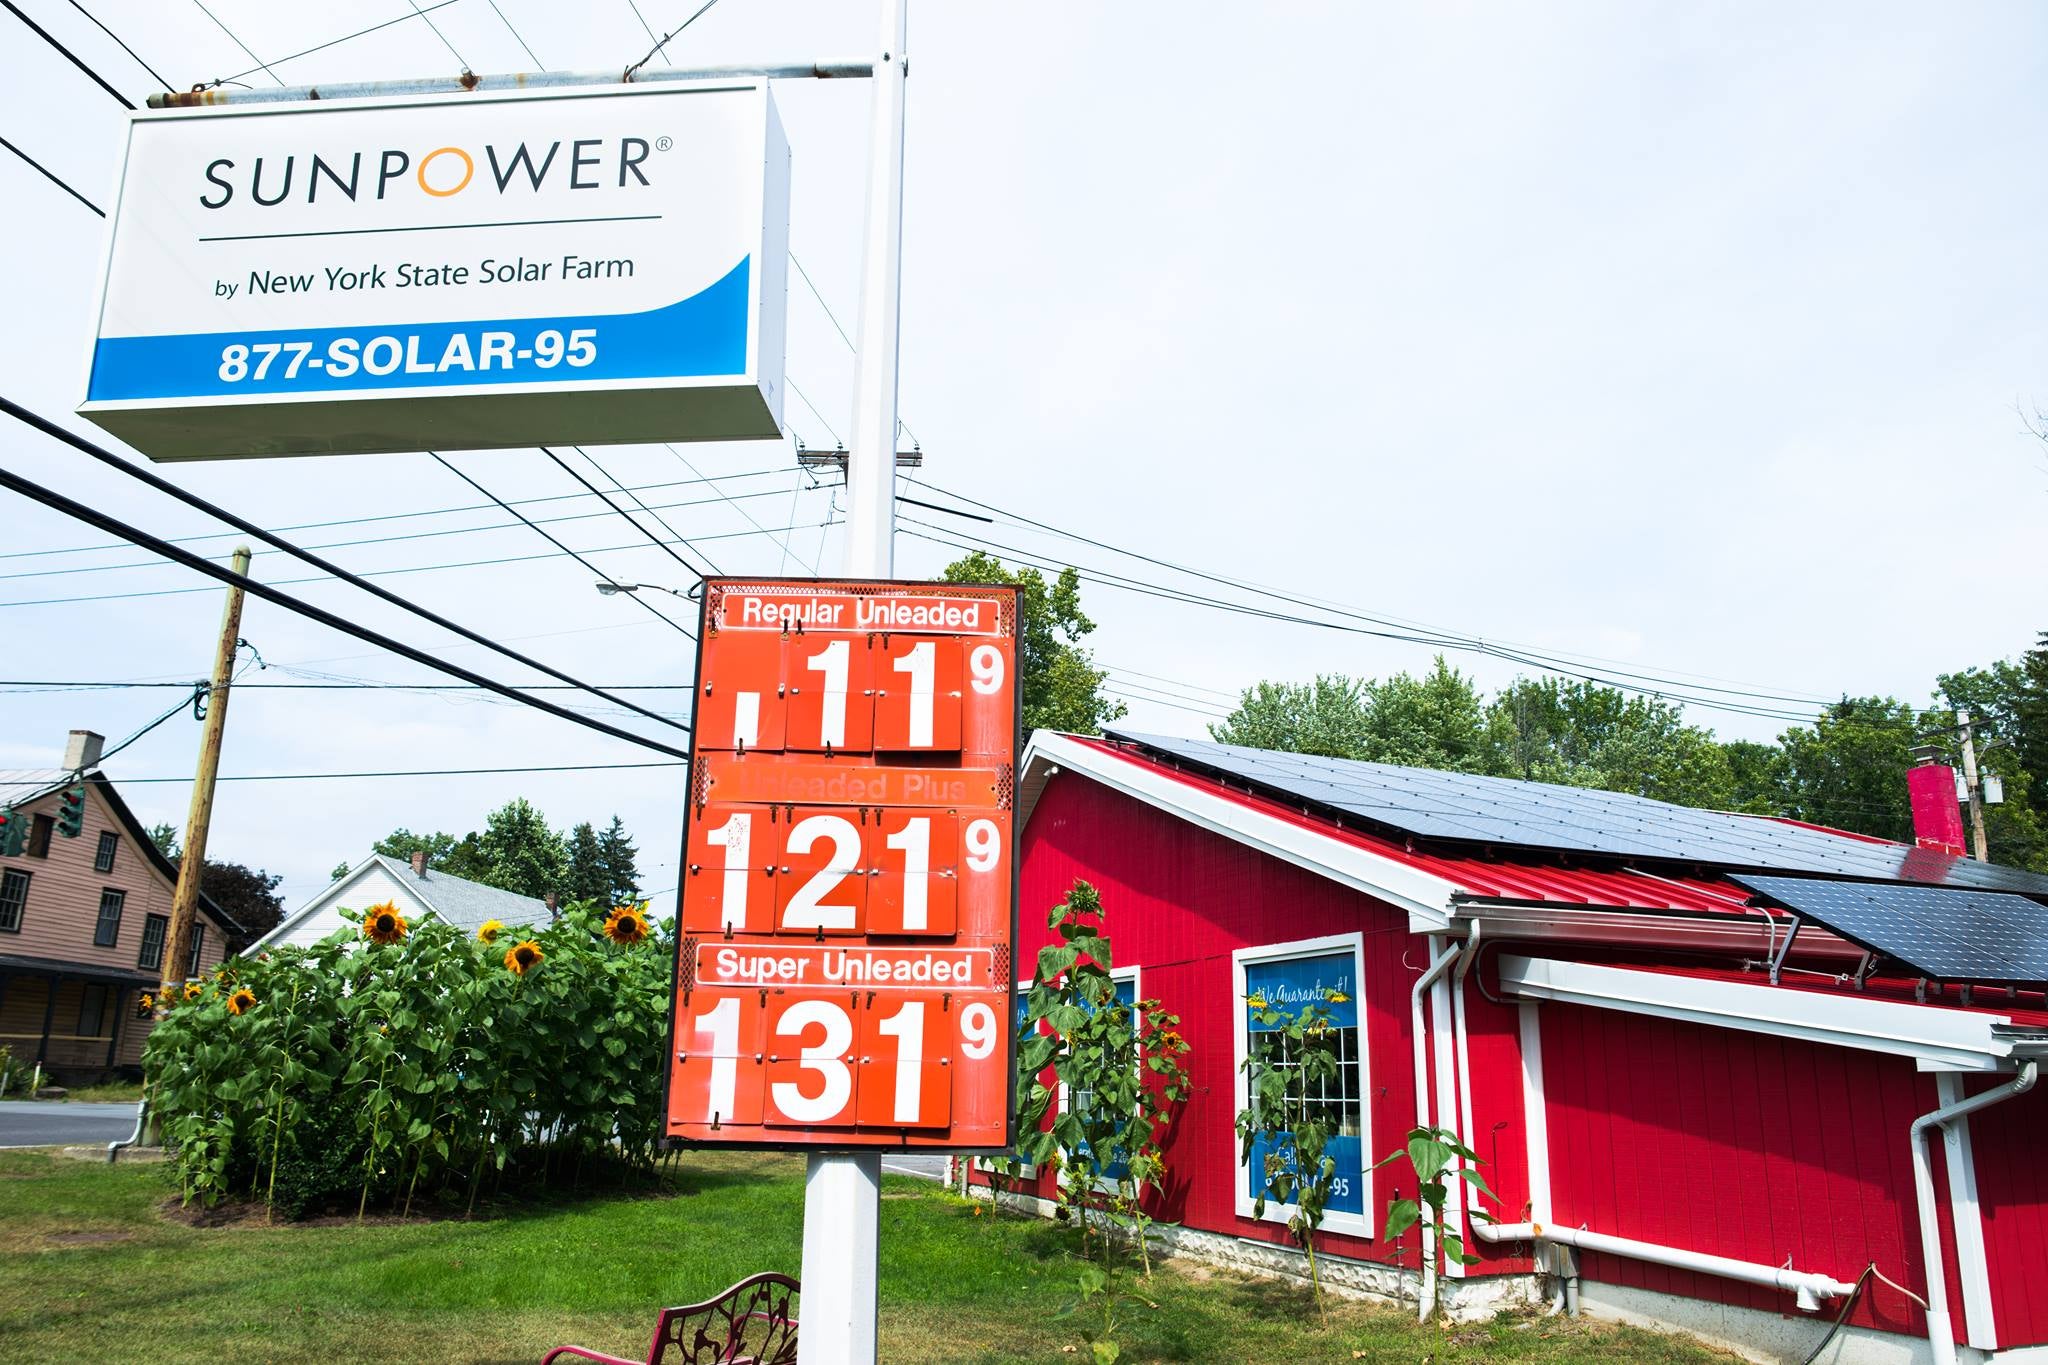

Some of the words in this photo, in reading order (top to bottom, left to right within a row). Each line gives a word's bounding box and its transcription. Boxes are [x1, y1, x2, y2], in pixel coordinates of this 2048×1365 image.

[215, 279, 239, 300] by
[248, 270, 315, 295] New
[325, 264, 387, 291] York
[396, 263, 469, 288] State
[480, 257, 553, 284] Solar
[562, 255, 635, 280] Farm
[218, 328, 598, 383] 877-SOLAR-95
[742, 597, 844, 627] Regular
[856, 599, 980, 628] Unleaded
[903, 774, 967, 800] Plus
[716, 948, 810, 984] Super
[822, 952, 973, 983] Unleaded
